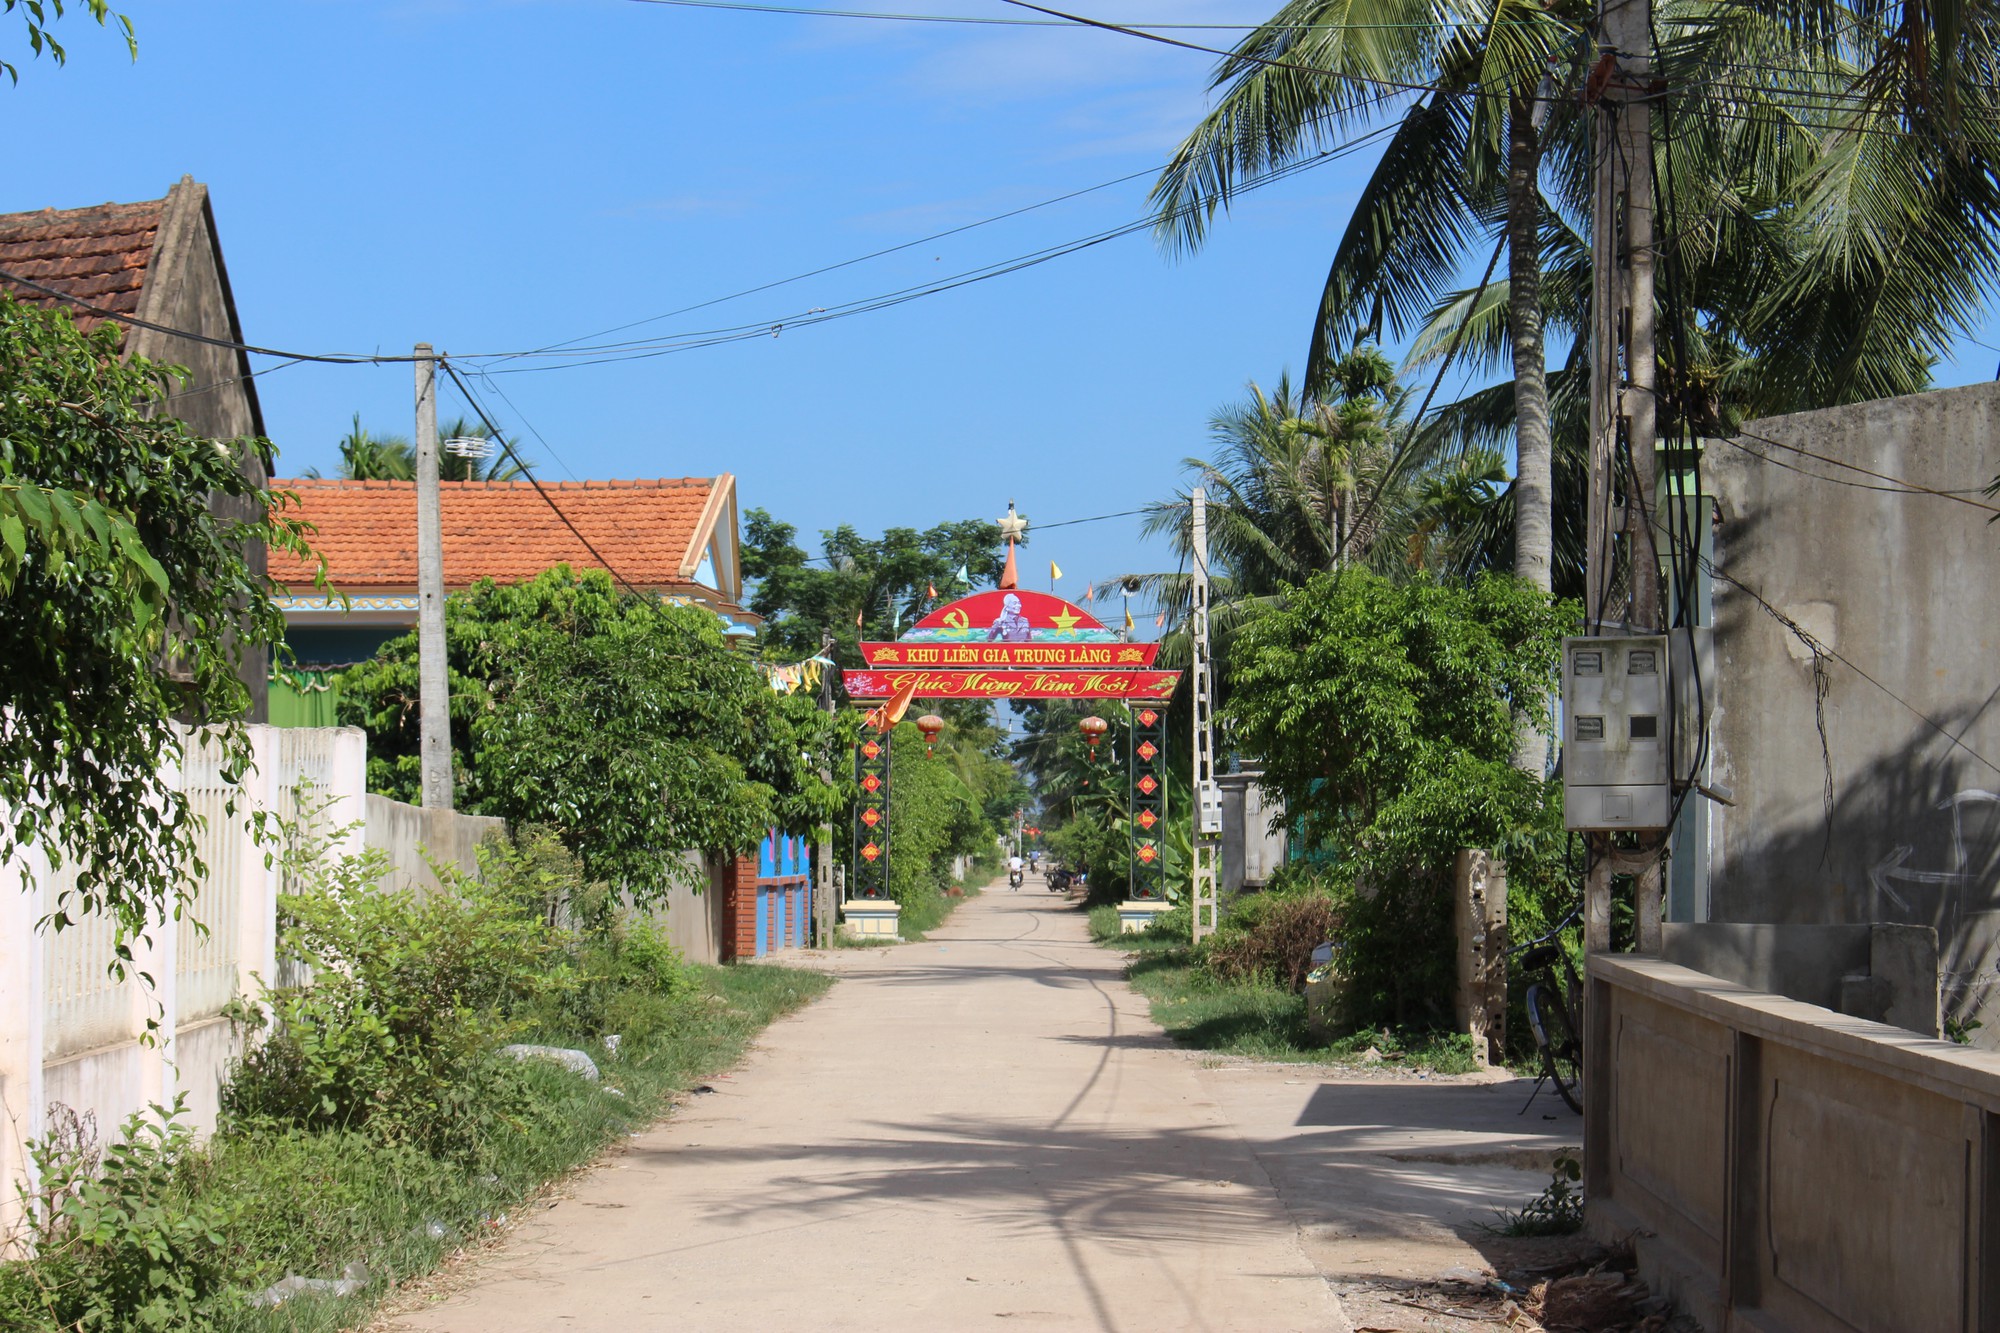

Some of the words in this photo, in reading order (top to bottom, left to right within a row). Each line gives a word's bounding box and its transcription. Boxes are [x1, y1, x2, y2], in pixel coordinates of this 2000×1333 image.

[906, 649, 939, 662] KHU
[943, 645, 979, 662] LIÊN
[983, 649, 1010, 662] GIA
[1014, 649, 1066, 662] TRUNG
[1069, 645, 1111, 662] LÀNG
[884, 672, 953, 692] Chúc
[951, 673, 1026, 696] Mừng
[1024, 673, 1077, 692] Năm
[1070, 673, 1138, 695] Mới
